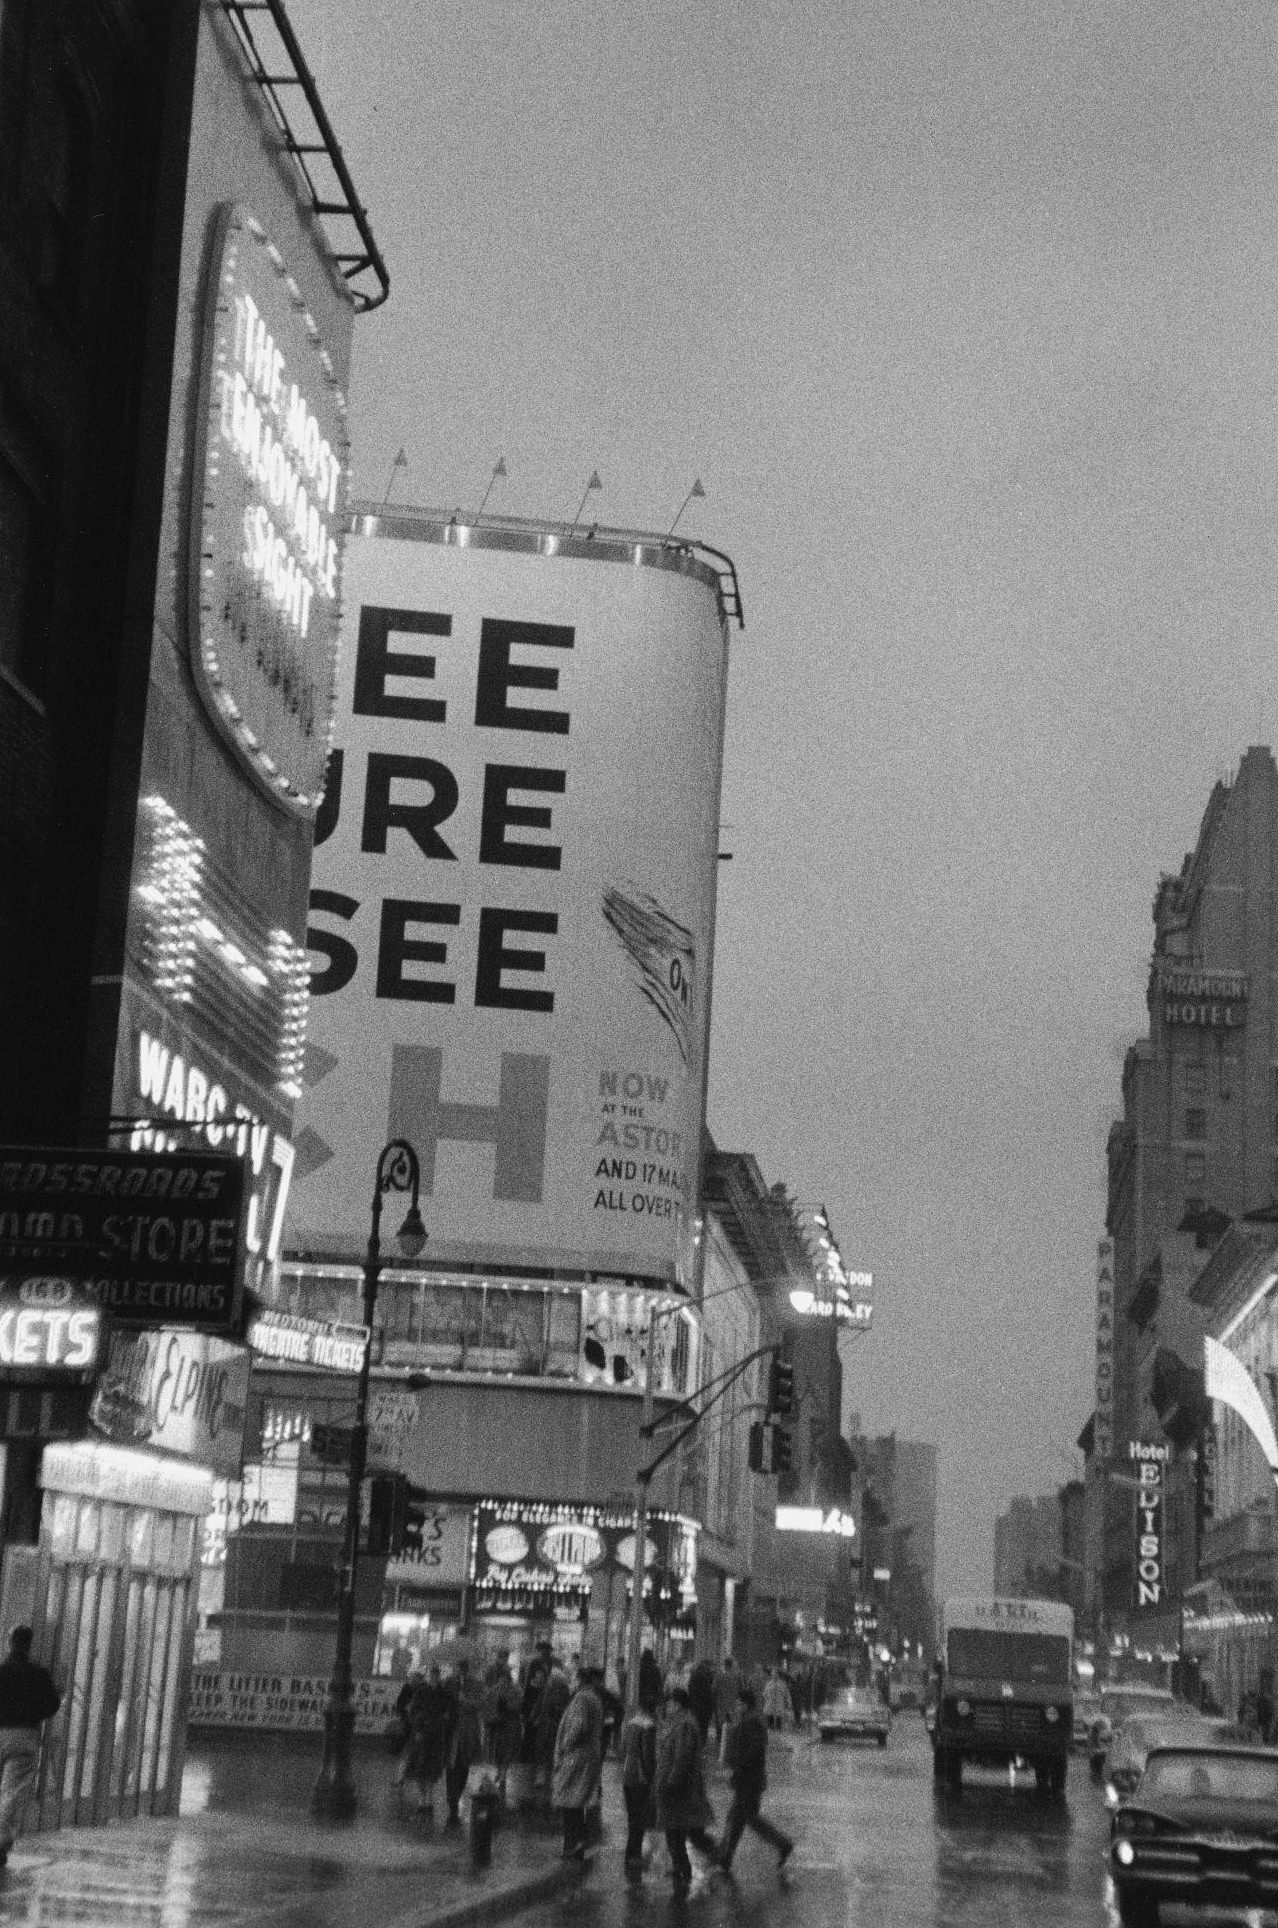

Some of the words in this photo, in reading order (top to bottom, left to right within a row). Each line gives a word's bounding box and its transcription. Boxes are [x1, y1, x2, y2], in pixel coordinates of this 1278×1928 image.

[286, 384, 341, 514] MOST
[226, 372, 338, 599] ENJOYABLE
[249, 506, 313, 638] SIGHT
[1166, 1003, 1237, 1026] HOTEL
[599, 1071, 669, 1103] NOW
[602, 1104, 617, 1114] AT
[621, 1105, 645, 1118] THE
[595, 1121, 682, 1158] ASTOR
[594, 1158, 637, 1180] AND
[642, 1163, 657, 1184] 17
[594, 1189, 627, 1211] ALL
[632, 1193, 672, 1219] OVER
[101, 1214, 237, 1265] STORE
[252, 1323, 310, 1362] THEATRE
[313, 1334, 366, 1373] TICKETS
[1097, 1242, 1113, 1453] PARAMOUNT
[1129, 1440, 1170, 1460] Hotel
[1138, 1464, 1162, 1607] EDISON
[228, 1675, 283, 1694] LITTER
[230, 1694, 256, 1710] THE
[265, 1696, 327, 1713] SIDEWAL
